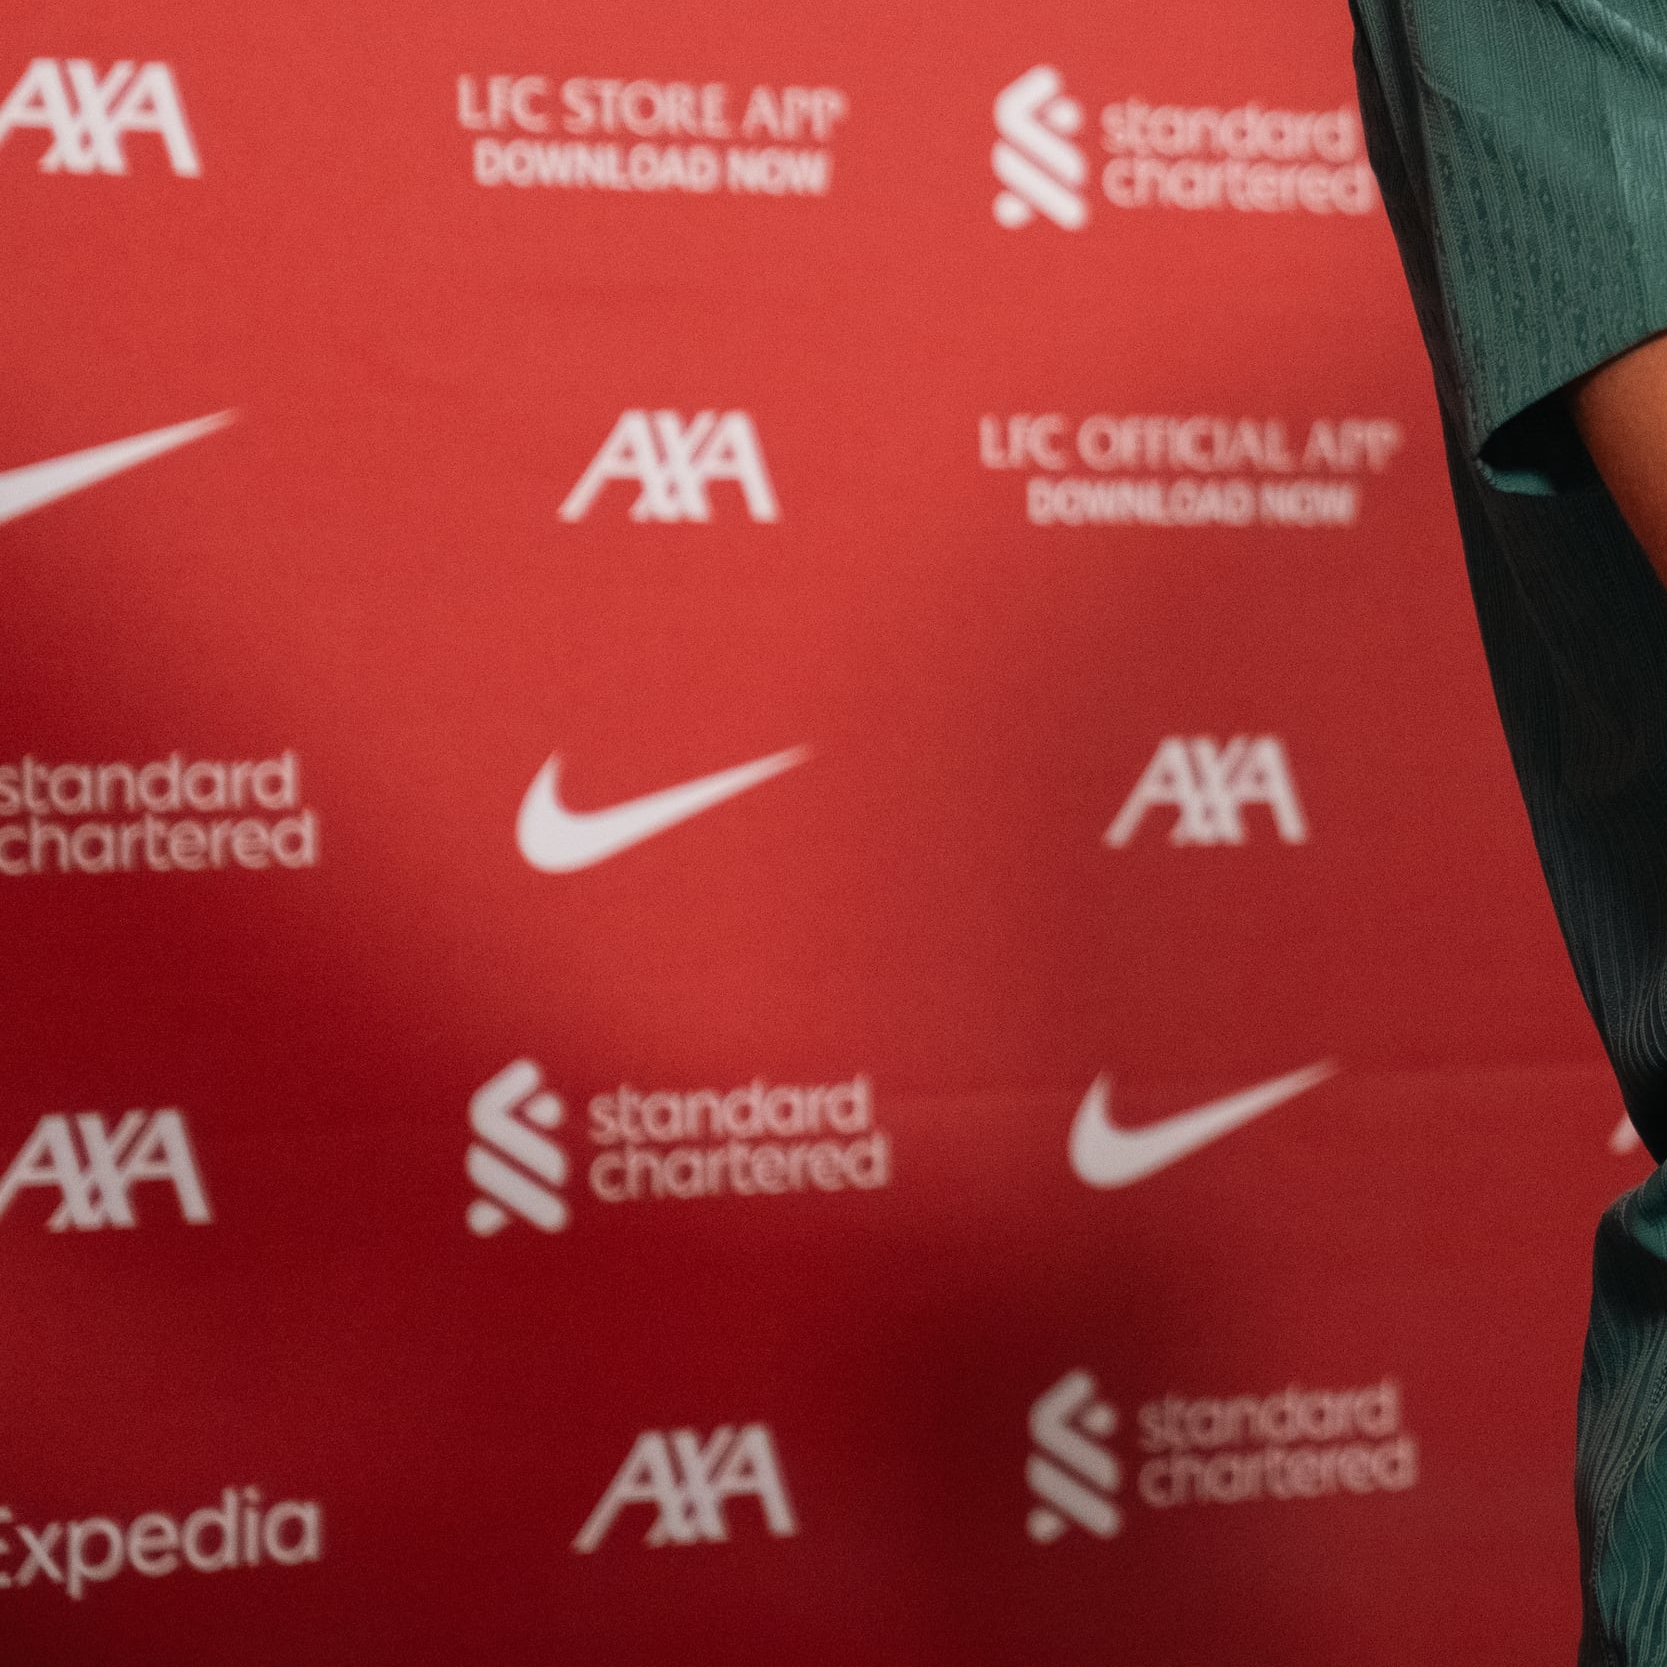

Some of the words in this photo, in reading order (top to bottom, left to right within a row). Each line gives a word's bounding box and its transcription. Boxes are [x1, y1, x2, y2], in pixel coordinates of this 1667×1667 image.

[0, 57, 201, 179] AXA
[457, 74, 548, 133] LFC
[563, 76, 727, 137] STORE
[742, 86, 851, 142] APP
[1101, 96, 1357, 164] standard
[472, 138, 719, 193] DOWNLOAD
[725, 146, 832, 198] NOW
[557, 407, 782, 525] AXA
[977, 414, 1068, 471] LFC
[1076, 414, 1294, 473] OFFICIAL
[1101, 734, 1309, 850] AXA
[0, 808, 319, 875] chartered
[587, 1074, 873, 1145] standard
[0, 1105, 213, 1234] AXA
[587, 1126, 893, 1202] chartered
[1138, 1379, 1402, 1451] standard
[571, 1422, 799, 1554] AXA
[1138, 1436, 1420, 1508] chartered
